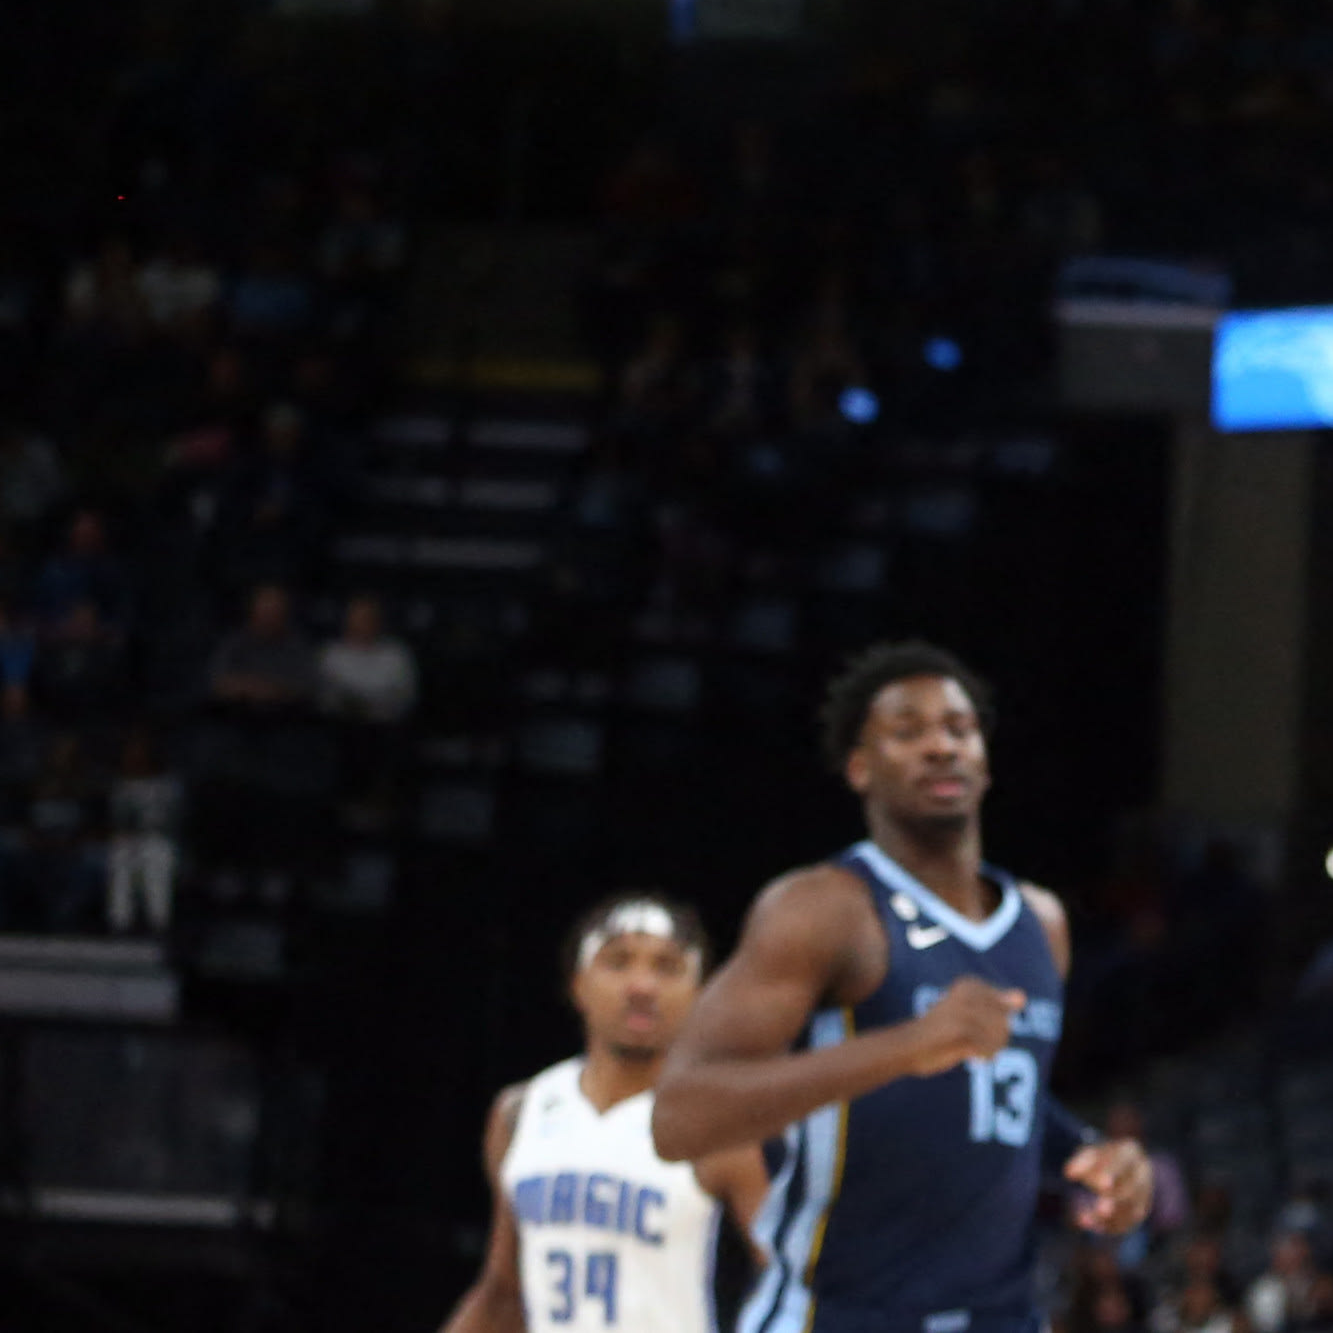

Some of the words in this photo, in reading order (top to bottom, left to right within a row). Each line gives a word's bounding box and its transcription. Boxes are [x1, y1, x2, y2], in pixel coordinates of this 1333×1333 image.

[966, 1048, 1038, 1148] 13
[514, 1170, 667, 1245] MAGIC
[547, 1249, 618, 1326] 34
